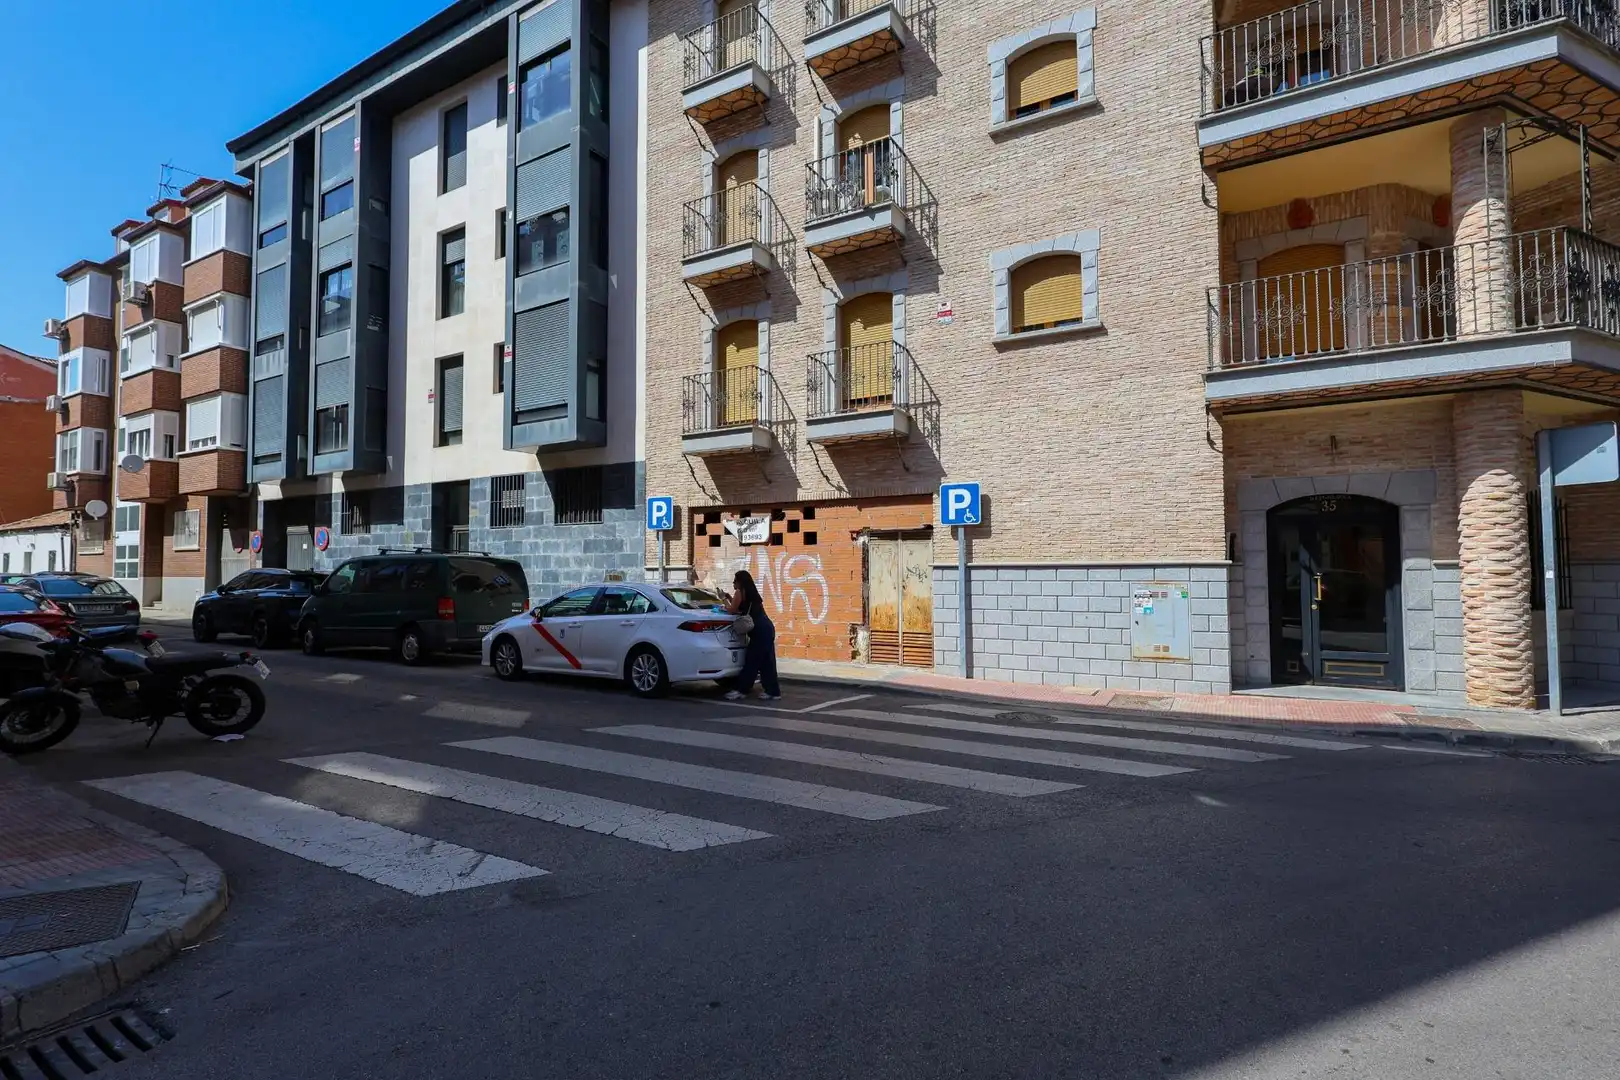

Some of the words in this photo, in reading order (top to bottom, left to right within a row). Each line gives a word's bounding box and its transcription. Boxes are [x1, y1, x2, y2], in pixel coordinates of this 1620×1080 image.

[652, 501, 667, 526] P
[948, 489, 971, 520] P
[1321, 500, 1337, 512] 35
